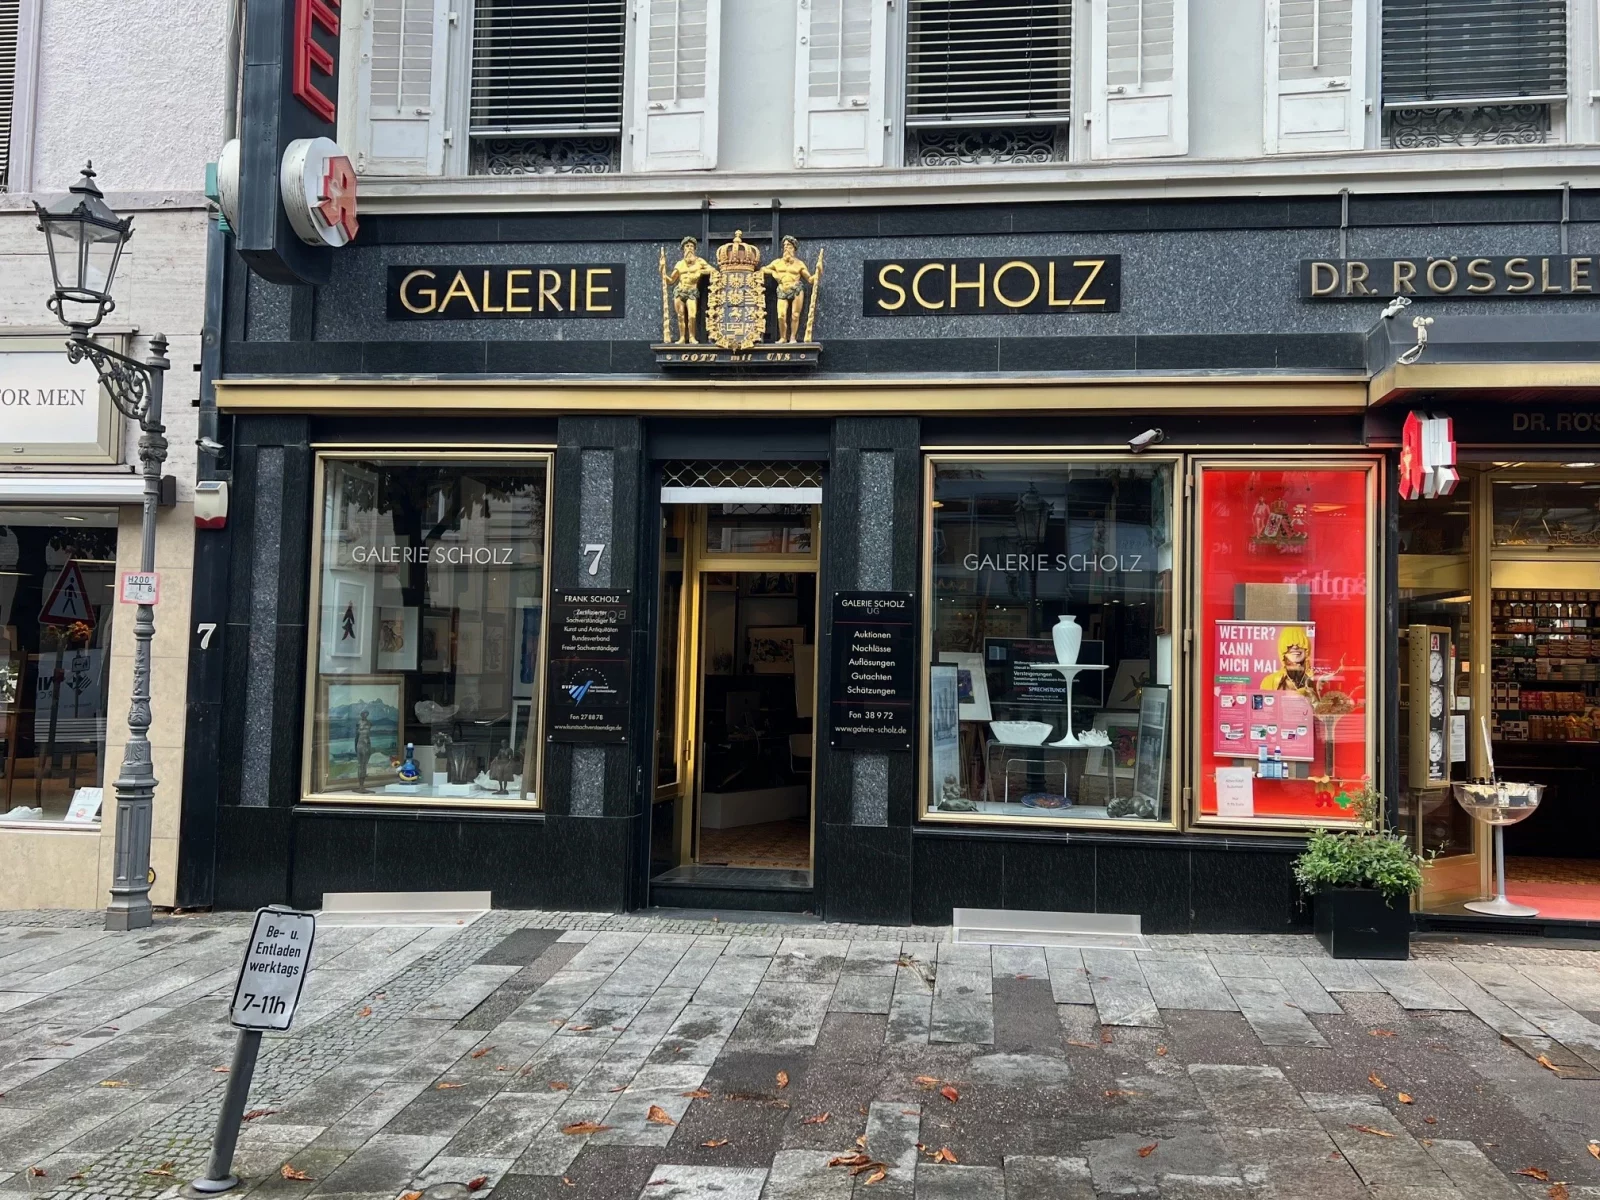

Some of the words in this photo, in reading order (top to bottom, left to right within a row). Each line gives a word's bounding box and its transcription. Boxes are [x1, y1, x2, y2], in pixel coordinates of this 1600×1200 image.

[877, 260, 1106, 310] SCHOLZ
[1311, 261, 1379, 296] DR.
[399, 268, 613, 314] GALERIE
[681, 353, 718, 361] GOTT
[766, 352, 790, 361] UNS
[0, 388, 31, 406] OR
[36, 388, 86, 406] MEN
[1512, 412, 1550, 431] DR.
[351, 545, 431, 563] GALERIE
[435, 547, 514, 564] SCHOLZ
[583, 543, 606, 576] 7
[963, 553, 1049, 571] GALERIE
[1055, 554, 1143, 572] SCHOLZ
[128, 576, 150, 584] H200
[564, 595, 588, 603] FRANK
[841, 599, 873, 608] GALERIE
[874, 600, 905, 608] SCHOLZ
[866, 607, 880, 615] UG
[196, 623, 217, 650] 7
[853, 630, 891, 639] Auktionen
[1219, 625, 1277, 641] WETTER?
[852, 644, 892, 653] Nachlässe
[1219, 641, 1254, 657] KANN
[848, 657, 896, 669] Auflösungen
[1219, 658, 1250, 673] MICH
[1253, 660, 1279, 674] MAL
[851, 672, 893, 681] Gutachten
[846, 685, 896, 697] Schätzungen
[848, 711, 862, 719] Fon
[834, 724, 907, 735] www.galerie-scholz.de
[266, 925, 285, 938] Be-
[290, 930, 299, 940] u.
[255, 941, 301, 958] Entladen
[250, 960, 299, 978] werktags
[241, 993, 286, 1015] 7-11h
